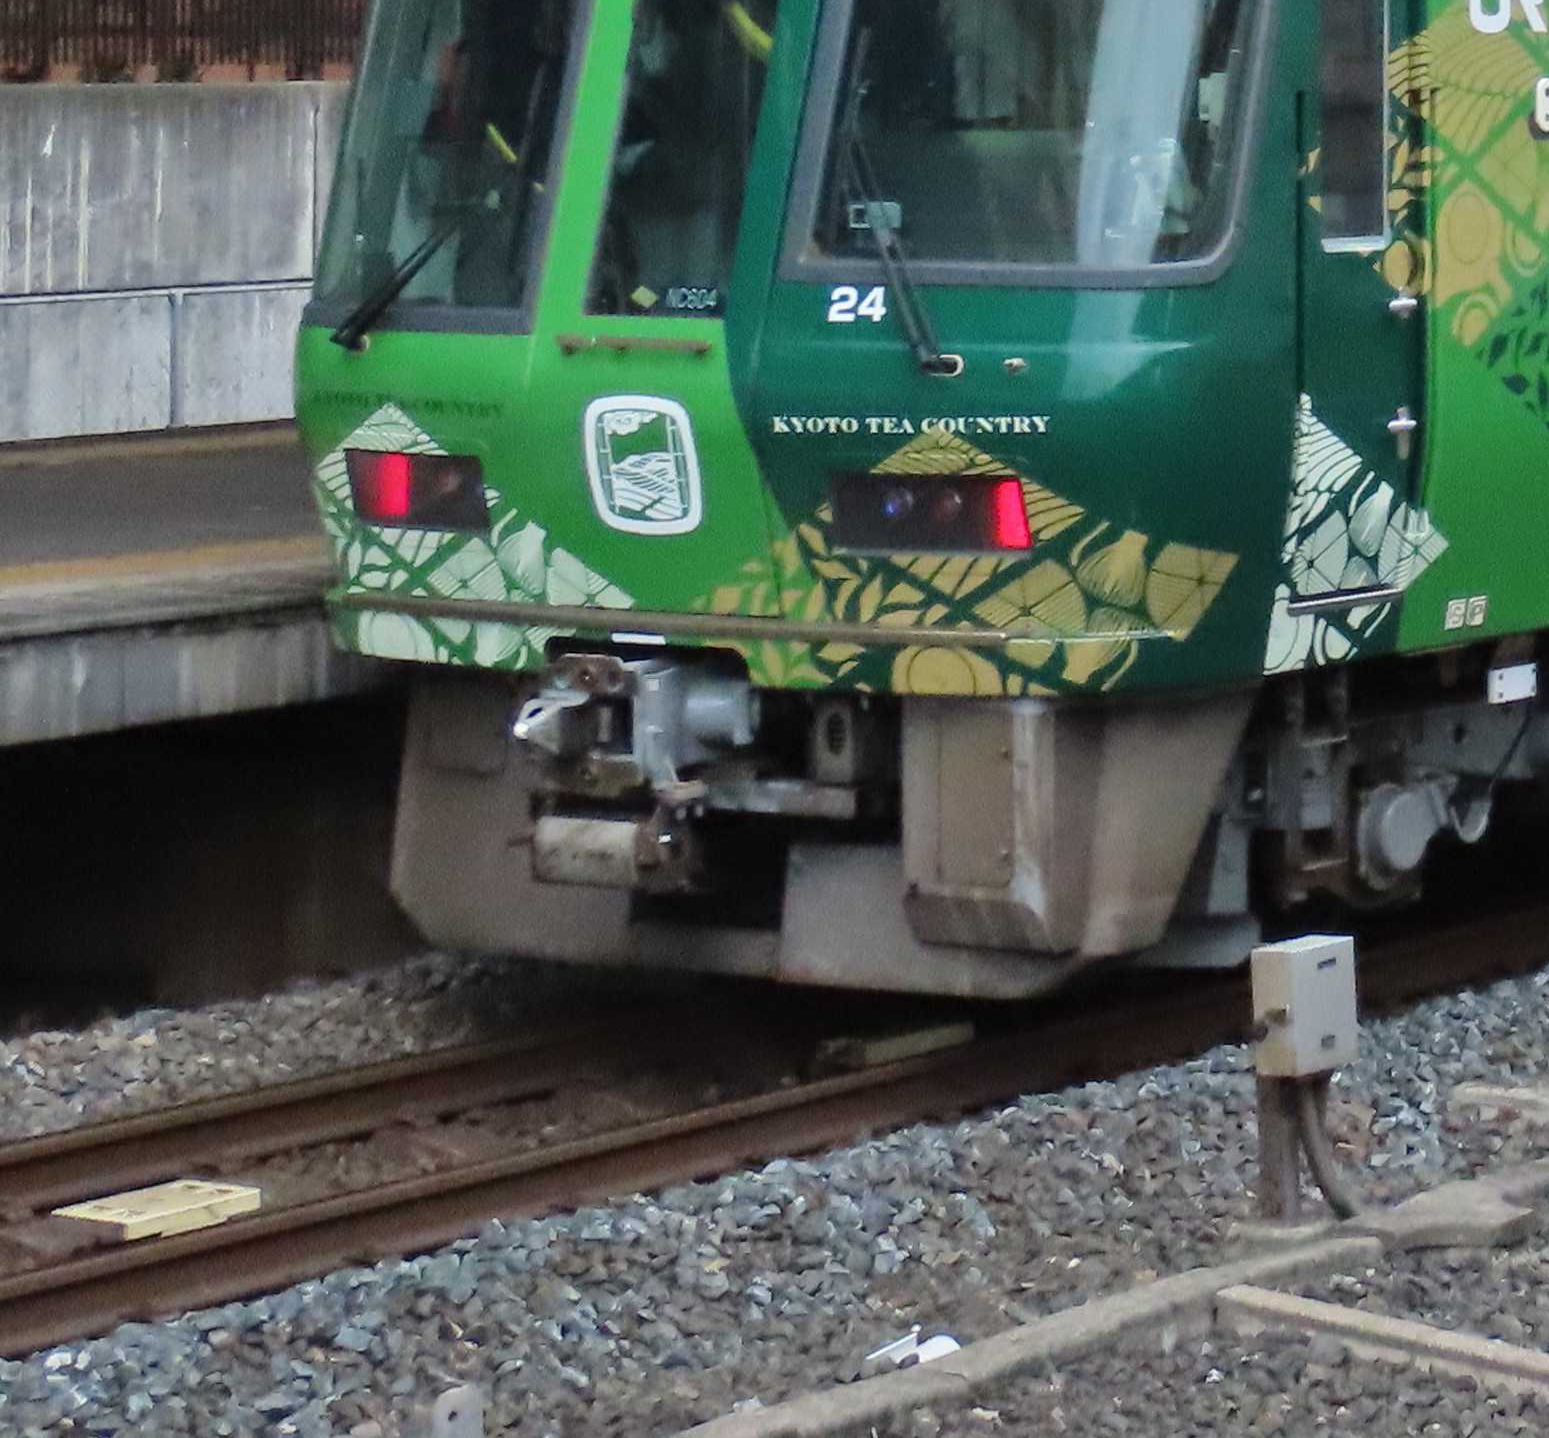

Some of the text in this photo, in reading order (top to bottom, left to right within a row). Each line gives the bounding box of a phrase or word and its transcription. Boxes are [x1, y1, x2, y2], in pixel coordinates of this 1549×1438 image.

[827, 285, 888, 323] 24
[772, 415, 1051, 434] KYOTO TEA COUNTRY
